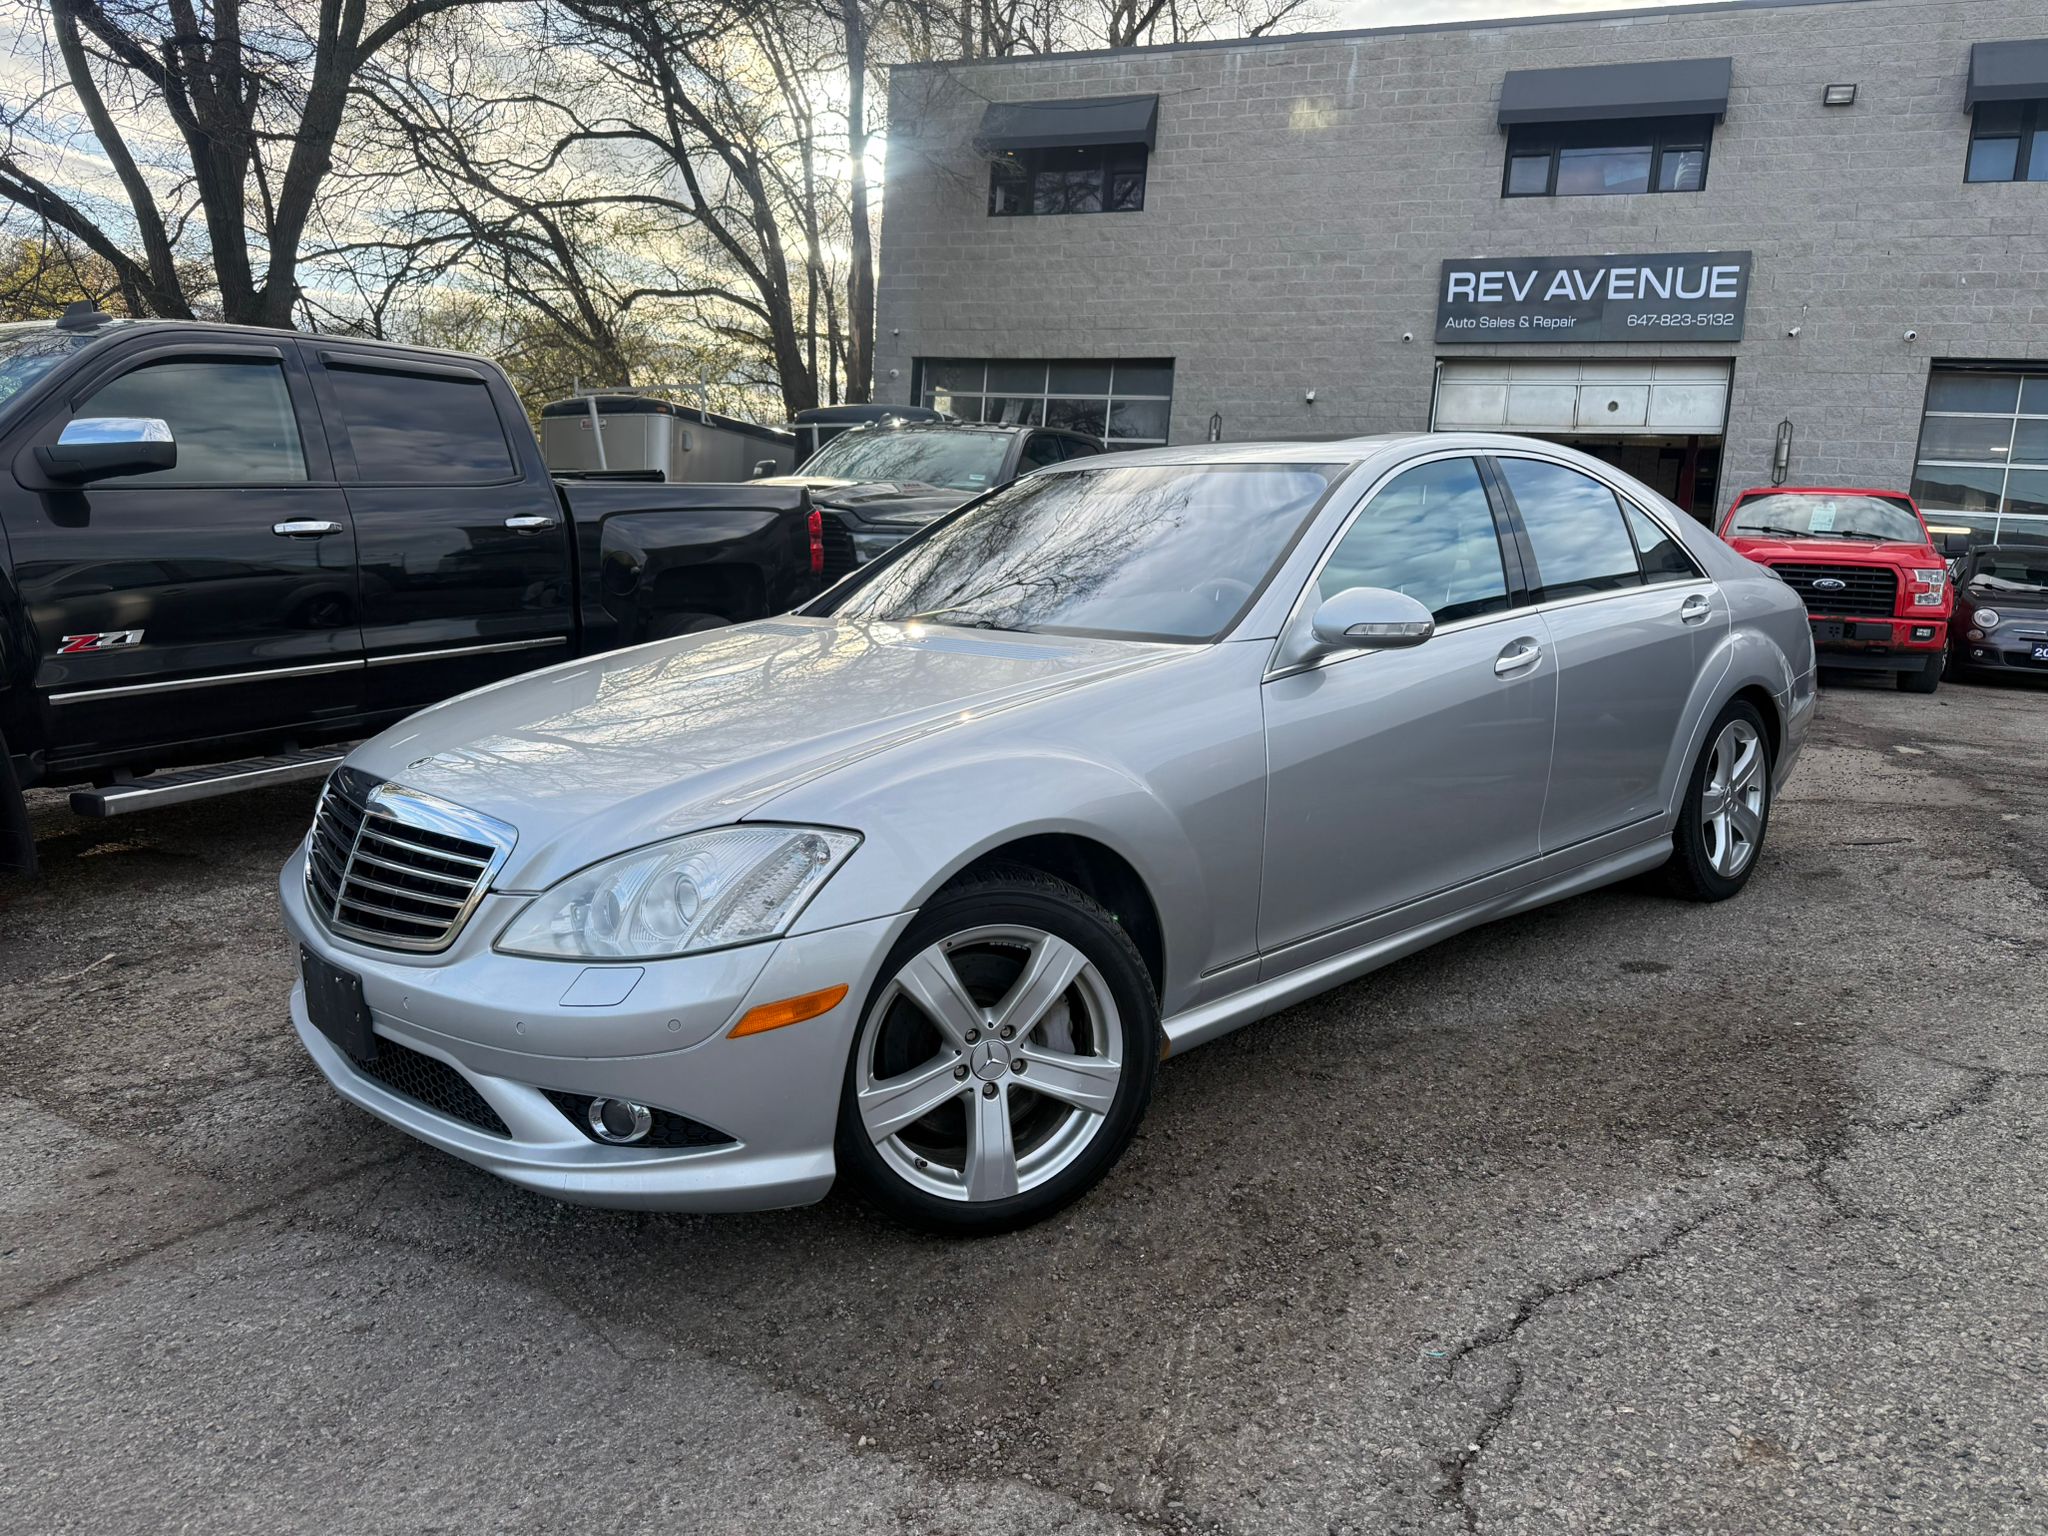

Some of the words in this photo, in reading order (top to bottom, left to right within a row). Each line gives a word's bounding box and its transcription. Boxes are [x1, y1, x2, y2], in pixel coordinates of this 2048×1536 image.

[1447, 271, 1538, 303] REV
[1544, 265, 1740, 301] AVENUE
[1445, 316, 1476, 328] Auto
[1479, 316, 1516, 328] Sales
[1519, 316, 1530, 328] &
[1533, 315, 1577, 330] Repair
[1627, 313, 1735, 327] 647-823-5132
[57, 629, 145, 654] Z71
